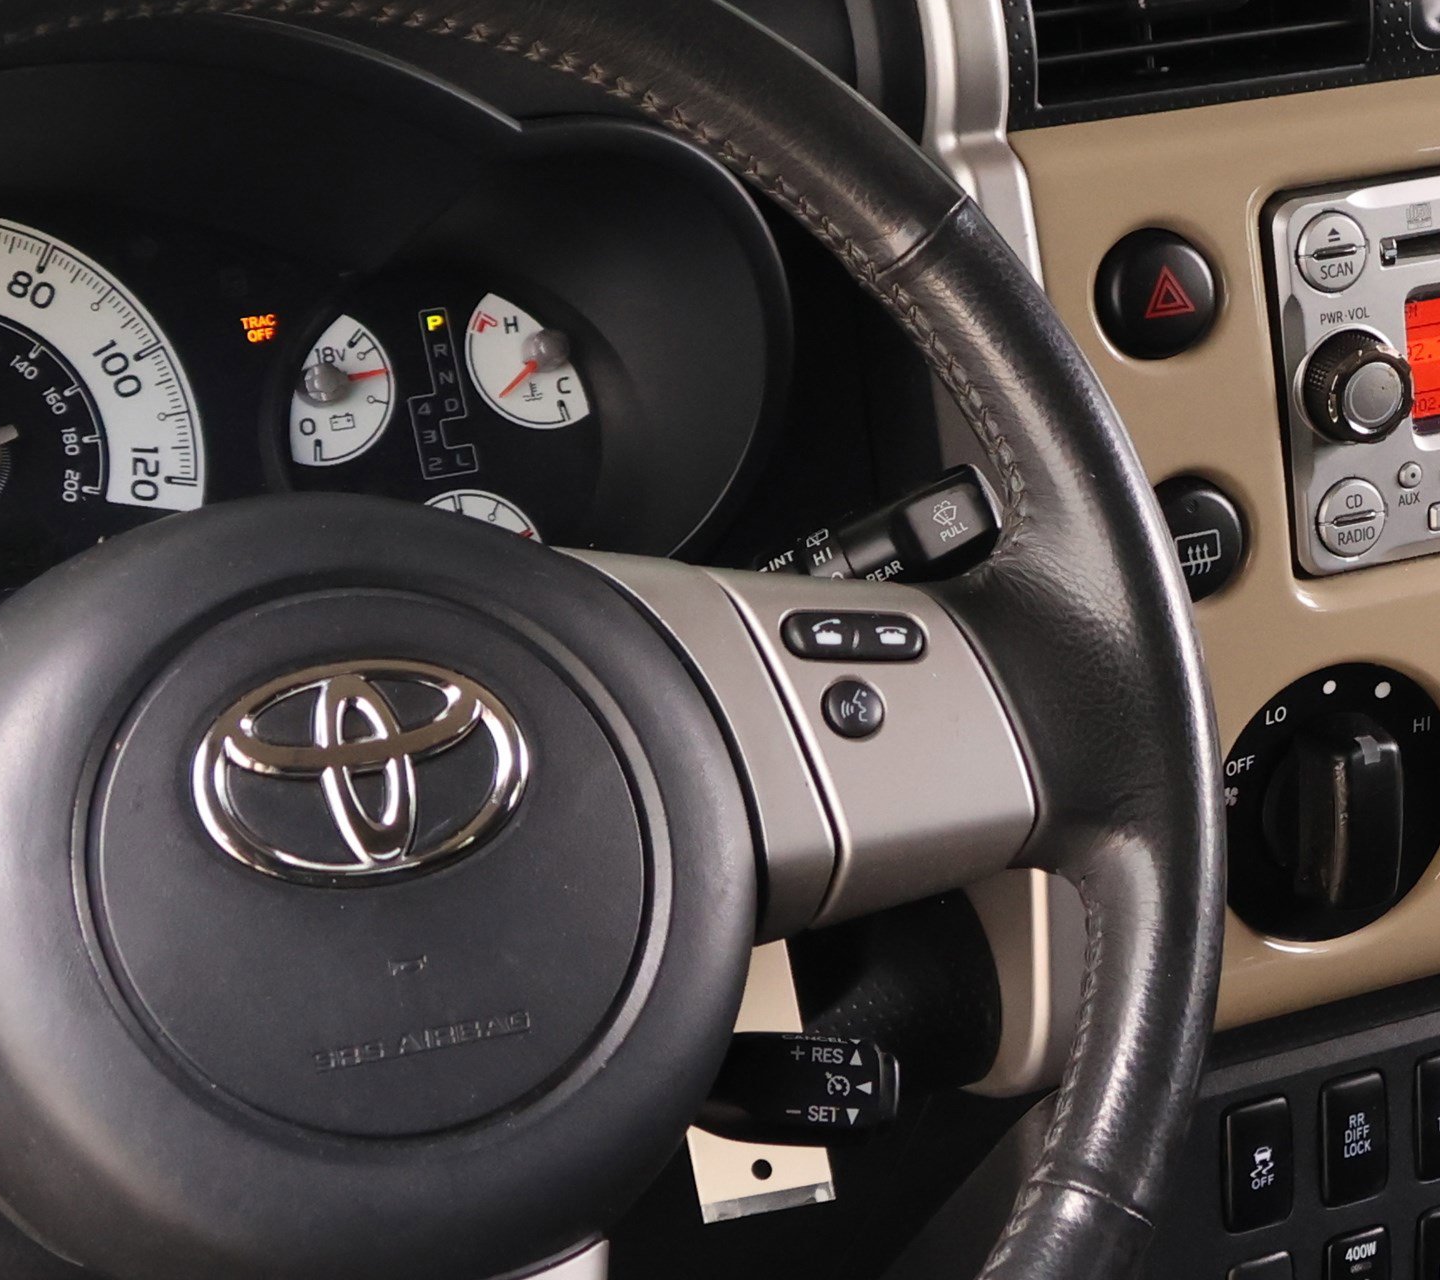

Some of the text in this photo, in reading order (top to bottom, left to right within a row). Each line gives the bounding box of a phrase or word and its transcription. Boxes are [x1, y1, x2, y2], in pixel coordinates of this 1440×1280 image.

[1320, 261, 1354, 280] SCAN
[6, 270, 56, 310] 80
[240, 313, 276, 330] TRAC
[426, 314, 444, 331] P
[503, 316, 519, 333] H
[246, 327, 275, 344] OFF
[433, 343, 446, 358] R
[9, 355, 39, 381] 140
[91, 338, 143, 399] 100
[439, 370, 454, 385] N
[556, 377, 570, 394] C
[41, 385, 68, 416] 160
[417, 403, 431, 416] 4
[445, 398, 459, 412] D
[60, 426, 81, 457] 180
[423, 429, 437, 444] 3
[428, 457, 442, 471] 2
[129, 445, 161, 502] 120
[61, 468, 82, 503] 200
[1345, 494, 1363, 509] CD
[1398, 491, 1421, 507] AUX
[940, 521, 969, 543] PULL
[1337, 526, 1375, 546] RADIO
[768, 549, 795, 571] INT
[812, 546, 833, 567] HI
[1265, 706, 1287, 726] LO
[1413, 715, 1431, 733] HI
[1225, 754, 1256, 777] OFF
[811, 1047, 844, 1064] RES
[807, 1106, 840, 1122] SET
[1349, 1112, 1365, 1128] RR
[1345, 1125, 1370, 1143] DIFF
[1344, 1139, 1371, 1158] LOCK
[1251, 1174, 1275, 1190] OFF
[1345, 1241, 1377, 1262] 400W
